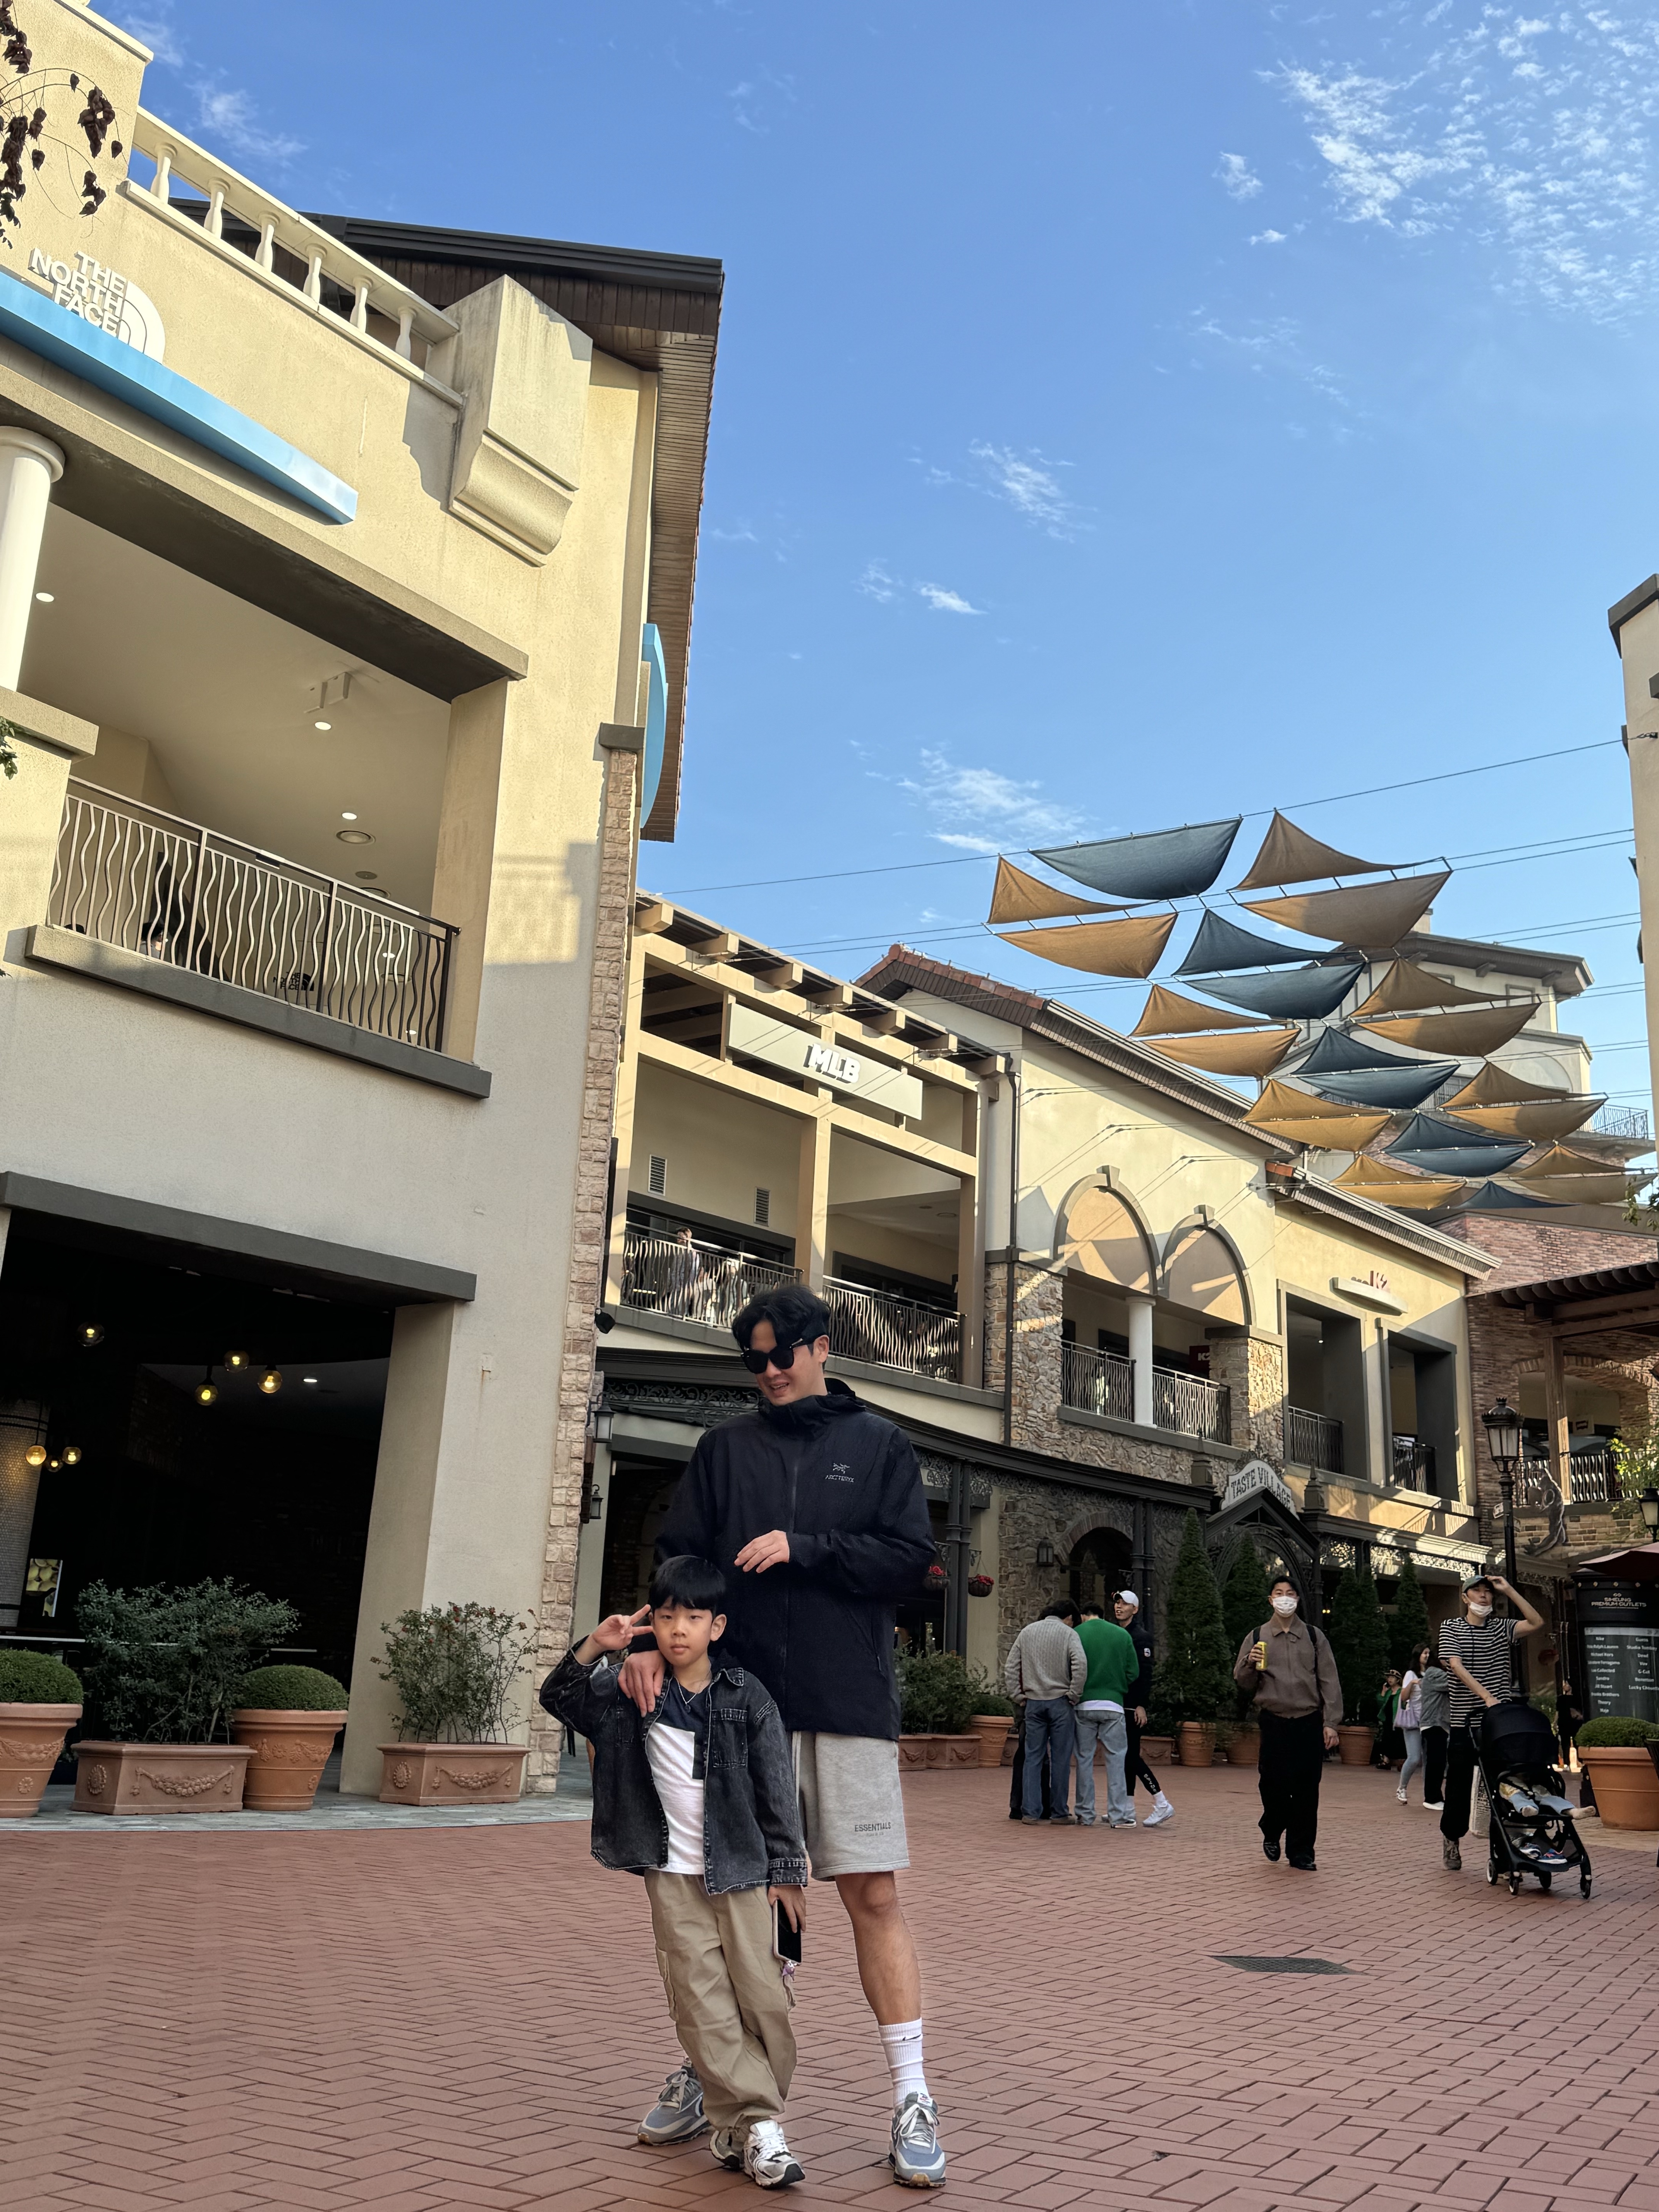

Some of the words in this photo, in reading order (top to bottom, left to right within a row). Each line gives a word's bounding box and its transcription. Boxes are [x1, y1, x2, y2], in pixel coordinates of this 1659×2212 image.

[29, 247, 124, 318] NORTH
[75, 250, 127, 297] THE
[54, 283, 120, 338] FACE
[807, 1043, 861, 1084] MLB
[1231, 1468, 1256, 1499] TASTE
[1257, 1467, 1291, 1510] VILLAGE
[854, 1822, 891, 1832] ESSENTIALS
